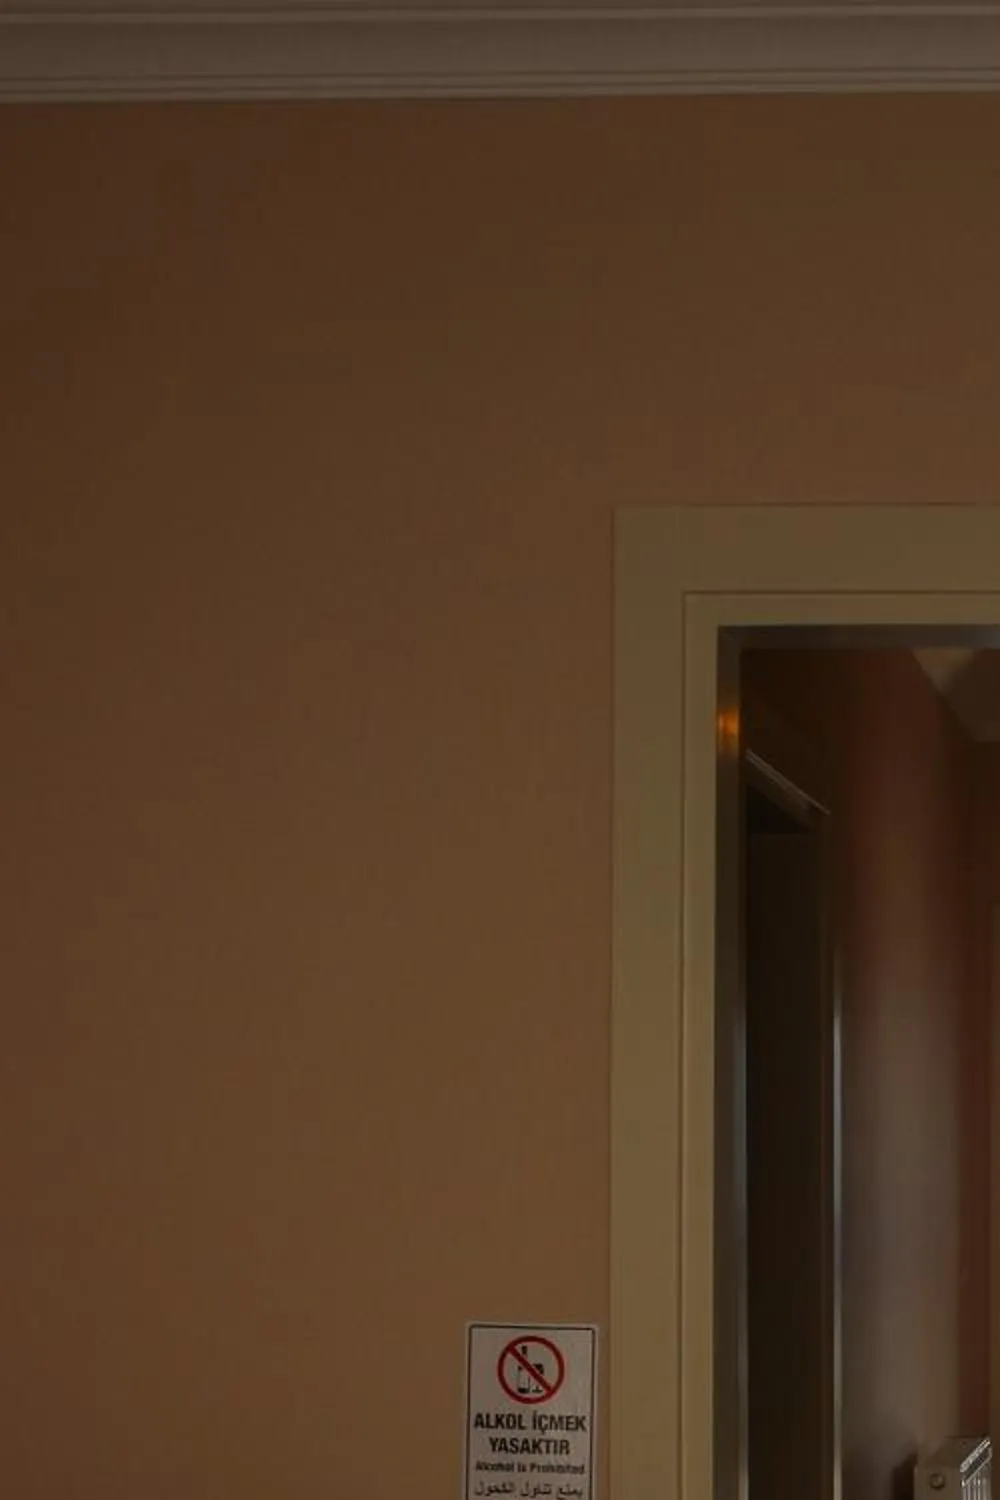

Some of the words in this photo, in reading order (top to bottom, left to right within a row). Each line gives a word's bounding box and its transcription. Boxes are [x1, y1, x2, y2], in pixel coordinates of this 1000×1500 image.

[474, 1412, 527, 1430] ALKOL
[532, 1410, 587, 1434] İÇMEK
[489, 1437, 570, 1455] YASAKTIR
